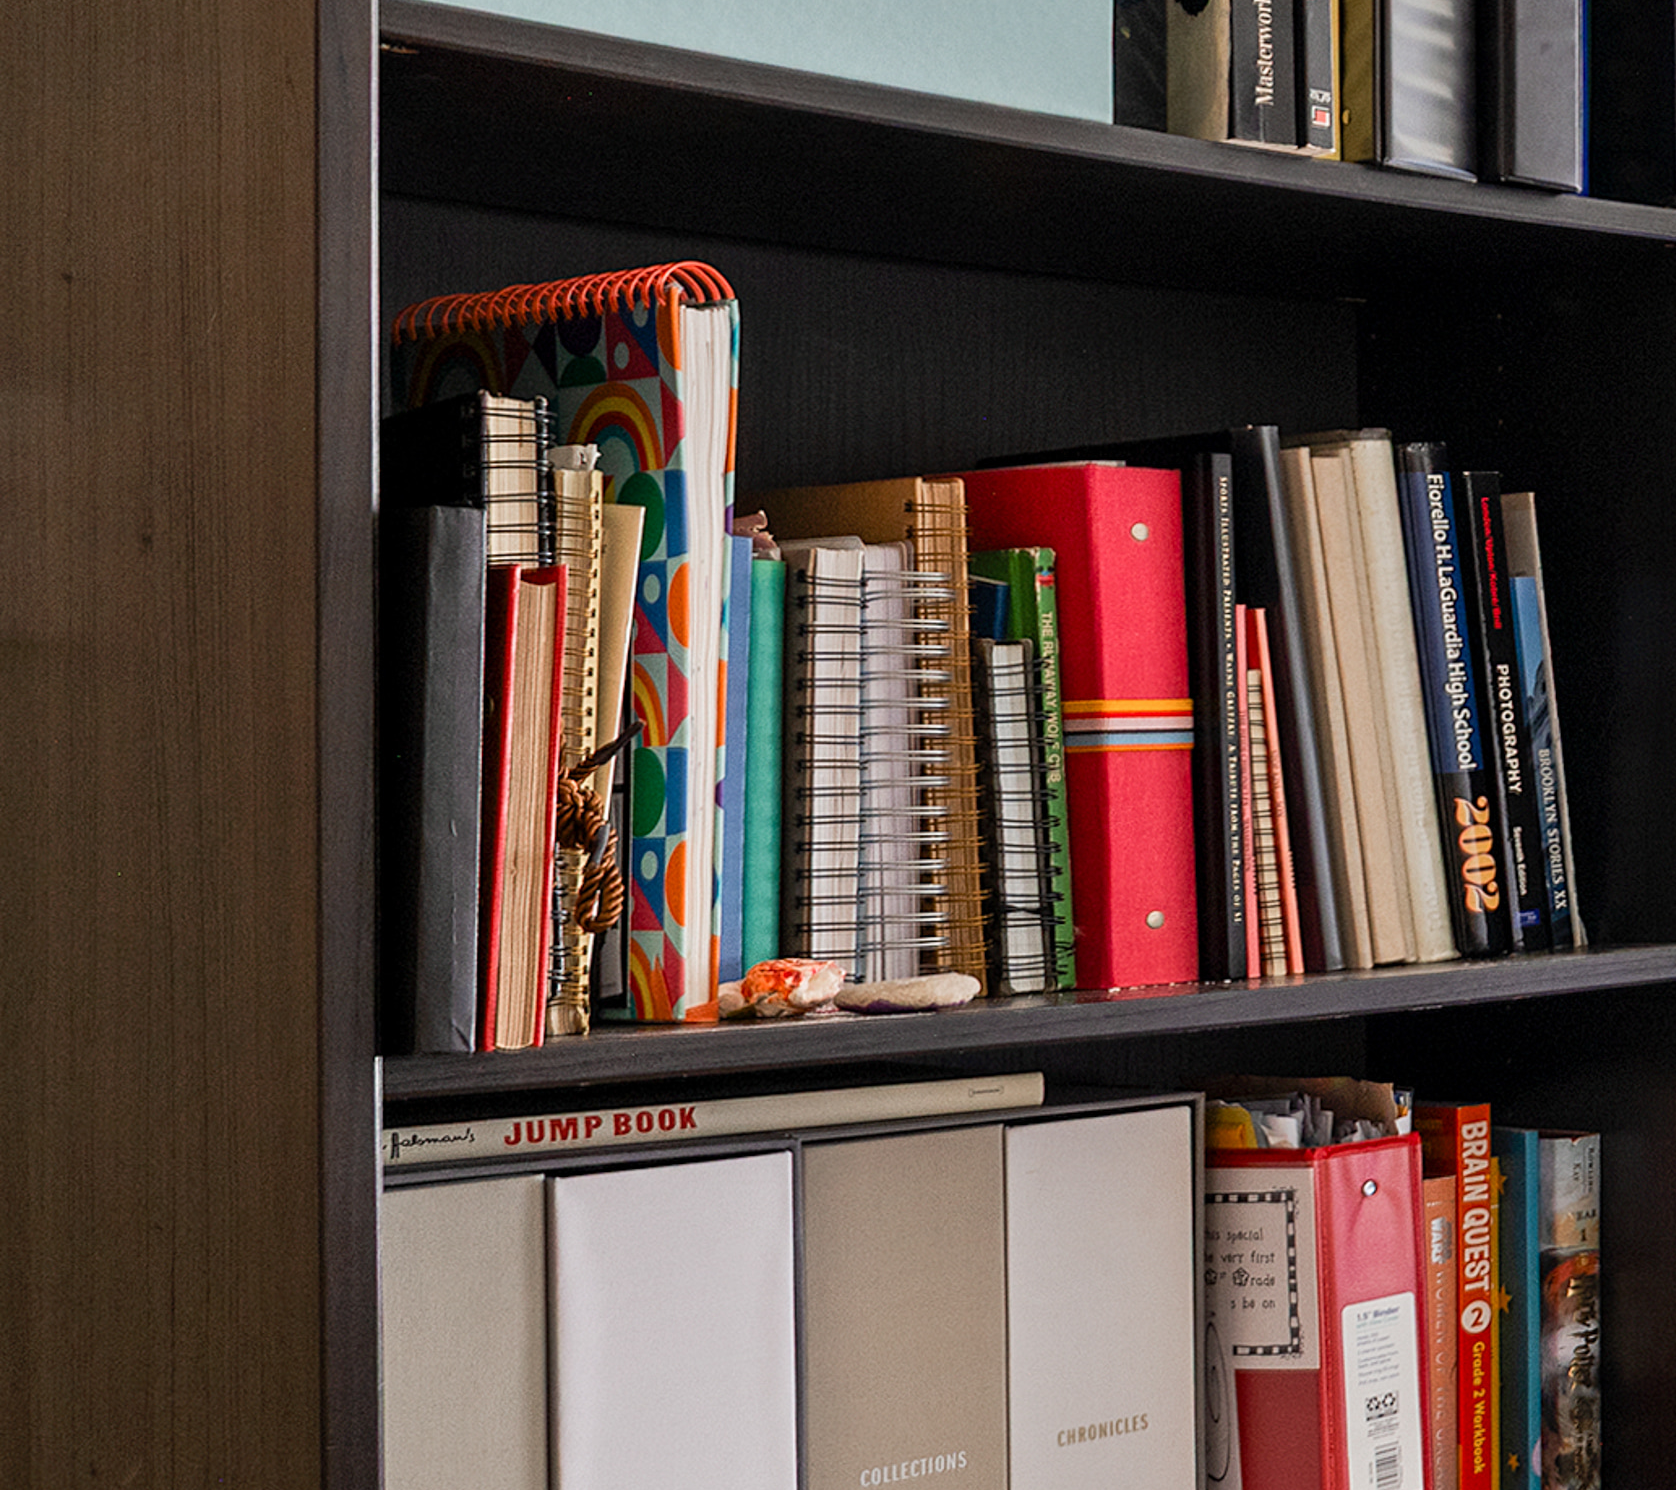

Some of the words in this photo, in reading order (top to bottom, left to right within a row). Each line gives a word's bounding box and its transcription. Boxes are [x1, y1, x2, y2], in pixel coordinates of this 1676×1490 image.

[1427, 474, 1449, 542] Fiorello
[1437, 565, 1464, 664] LaGuardia
[1444, 662, 1469, 706] High
[1453, 708, 1478, 771] School
[1497, 663, 1523, 796] PHOTOGRAPHY
[1538, 747, 1558, 823] BROOKLYN
[1454, 795, 1500, 913] 2002
[1547, 828, 1565, 886] STORIES
[504, 1115, 603, 1146] JUMP
[613, 1106, 697, 1137] BOOK
[1461, 1119, 1489, 1203] BRAIN
[1463, 1207, 1490, 1295] QUEST
[1472, 1341, 1485, 1387] Grade
[1057, 1413, 1149, 1447] CHRONICLES
[1472, 1400, 1488, 1475] Workbook
[860, 1451, 968, 1487] COLLECTIONS
